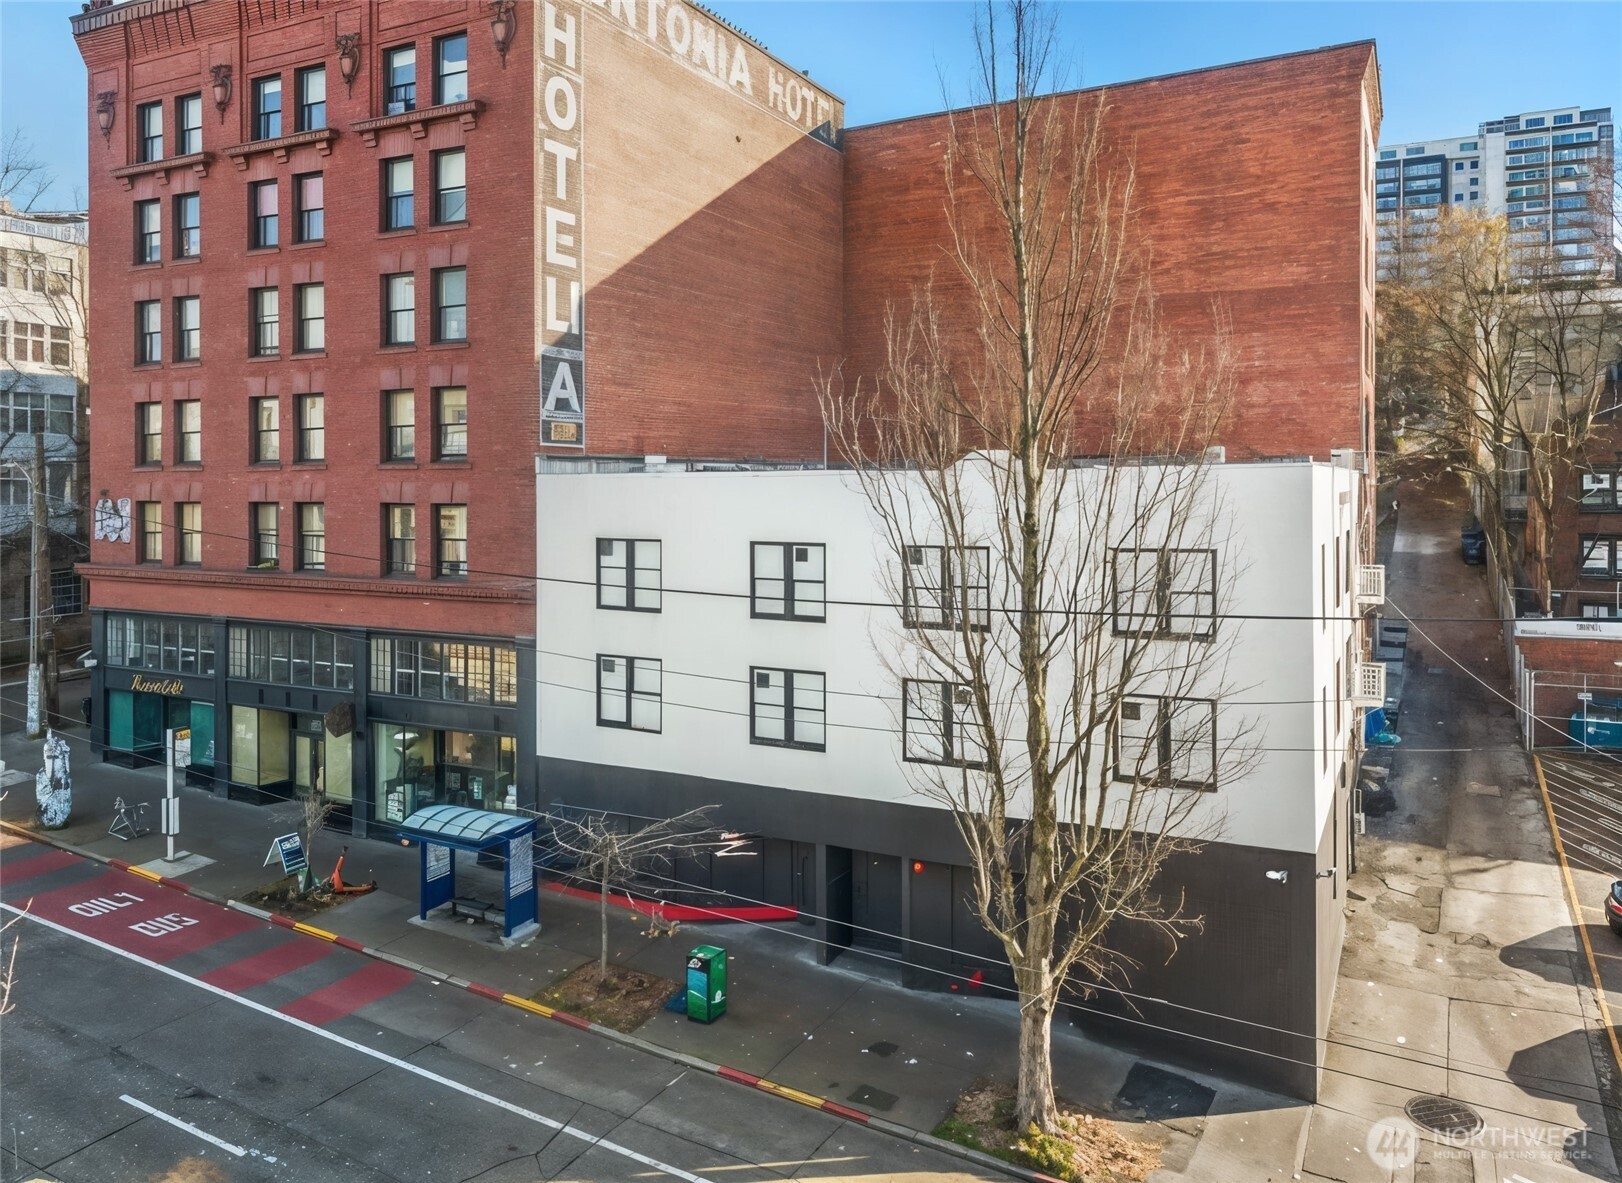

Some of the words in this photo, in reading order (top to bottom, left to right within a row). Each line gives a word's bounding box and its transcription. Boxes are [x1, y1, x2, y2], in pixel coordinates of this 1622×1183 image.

[593, 0, 753, 97] NTONIA
[544, 3, 580, 335] HOTEL
[543, 361, 581, 413] A
